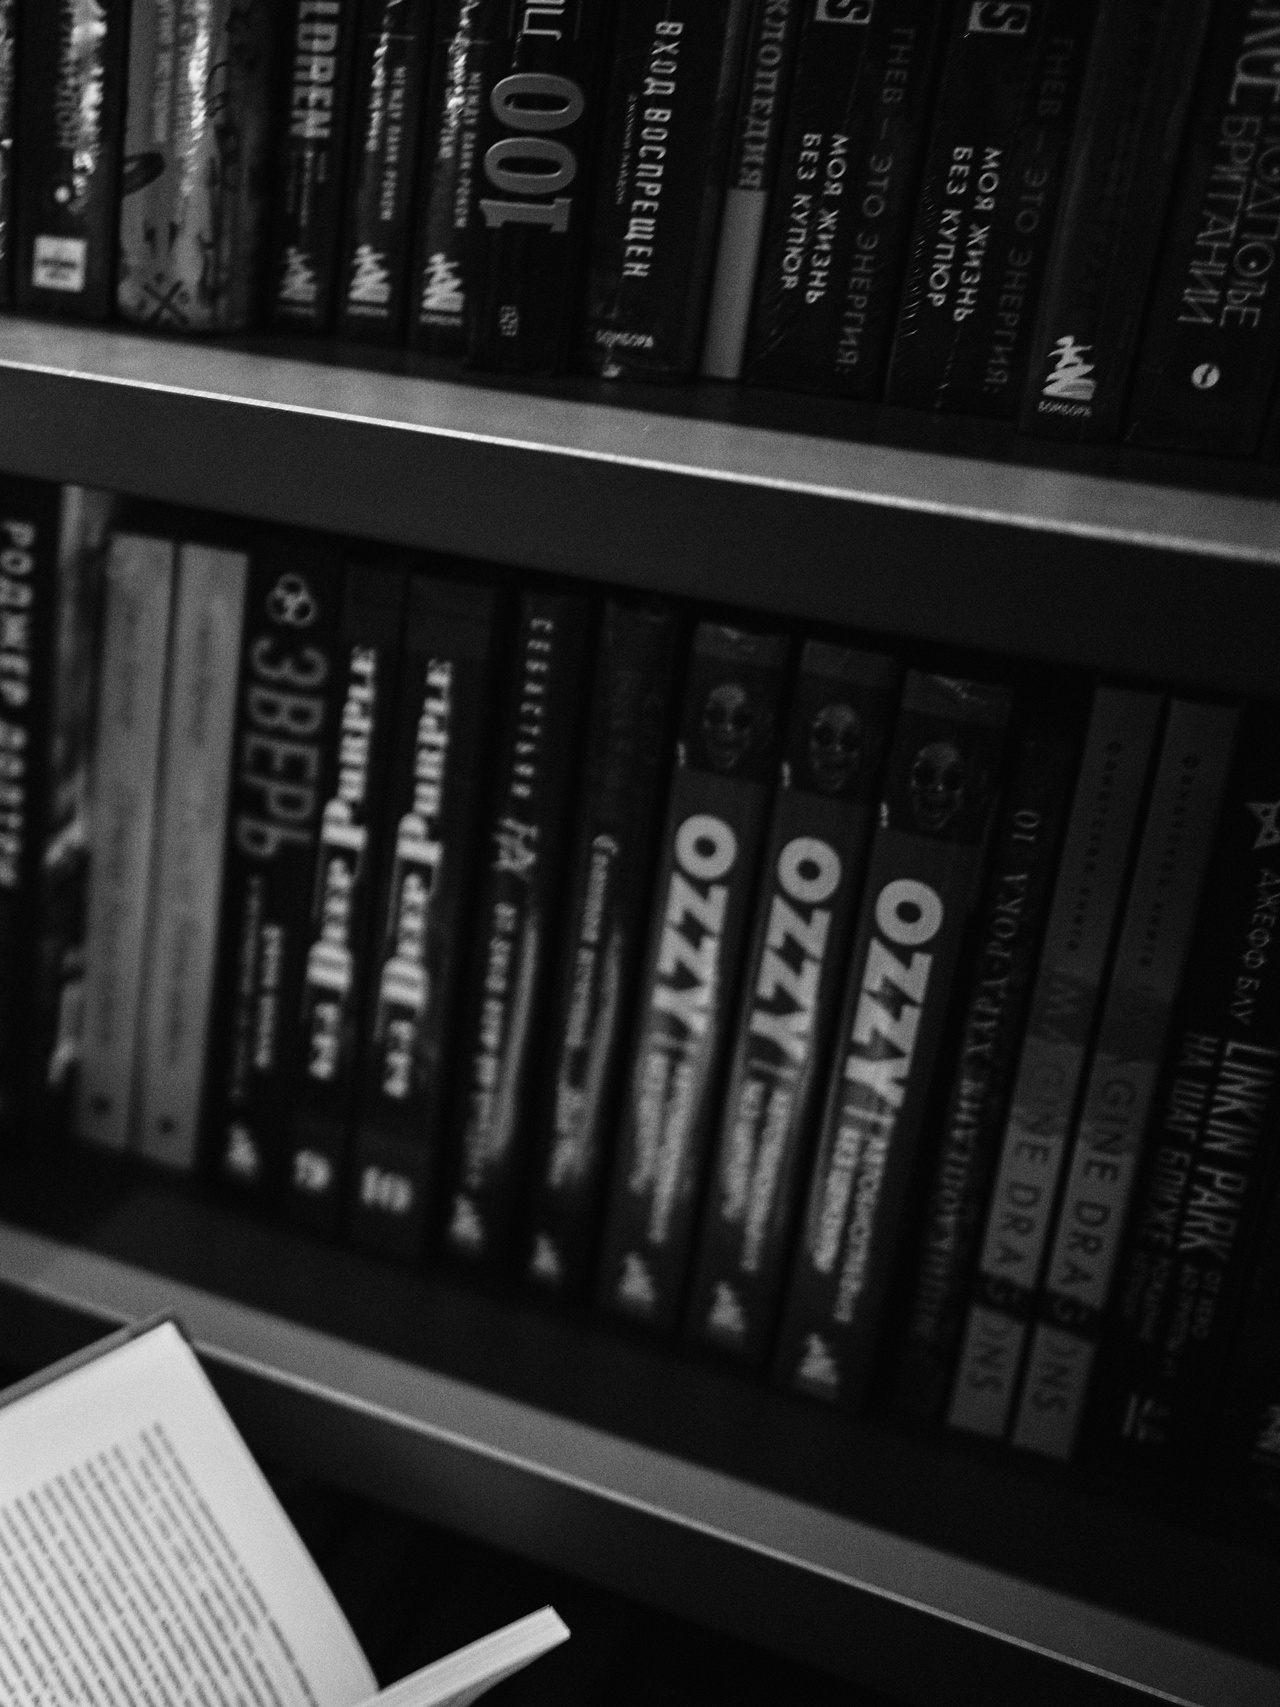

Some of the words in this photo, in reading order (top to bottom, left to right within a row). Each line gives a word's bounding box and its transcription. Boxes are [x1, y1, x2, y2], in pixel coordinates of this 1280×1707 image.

[641, 20, 685, 97] ВХОД
[881, 27, 916, 105] ГНЕВ
[478, 71, 587, 234] 100
[622, 107, 673, 278] ВОСПРЕЩЕН
[796, 132, 823, 182] БЕЗ
[822, 132, 851, 197] МОЯ
[861, 153, 895, 219] ЭТО
[945, 145, 974, 196] БЕЗ
[973, 146, 1004, 211] МОЯ
[1016, 166, 1050, 234] ЭТО
[780, 193, 813, 290] КУПЮР
[804, 207, 840, 304] ЖИЗНЬ
[926, 207, 963, 308] КУПЮР
[1177, 114, 1263, 327] БРИТАНИИ
[952, 222, 991, 323] ЖИЗНЬ
[234, 634, 330, 861] ЗВЕРЬ
[651, 812, 739, 1037] OZZY
[749, 835, 843, 1064] OZZY
[843, 876, 945, 1110] OZZY
[1178, 1030, 1220, 1069] НА
[1164, 1078, 1209, 1143] ШАГ
[1201, 1039, 1280, 1159] LINKIN
[1177, 1163, 1248, 1264] PARK
